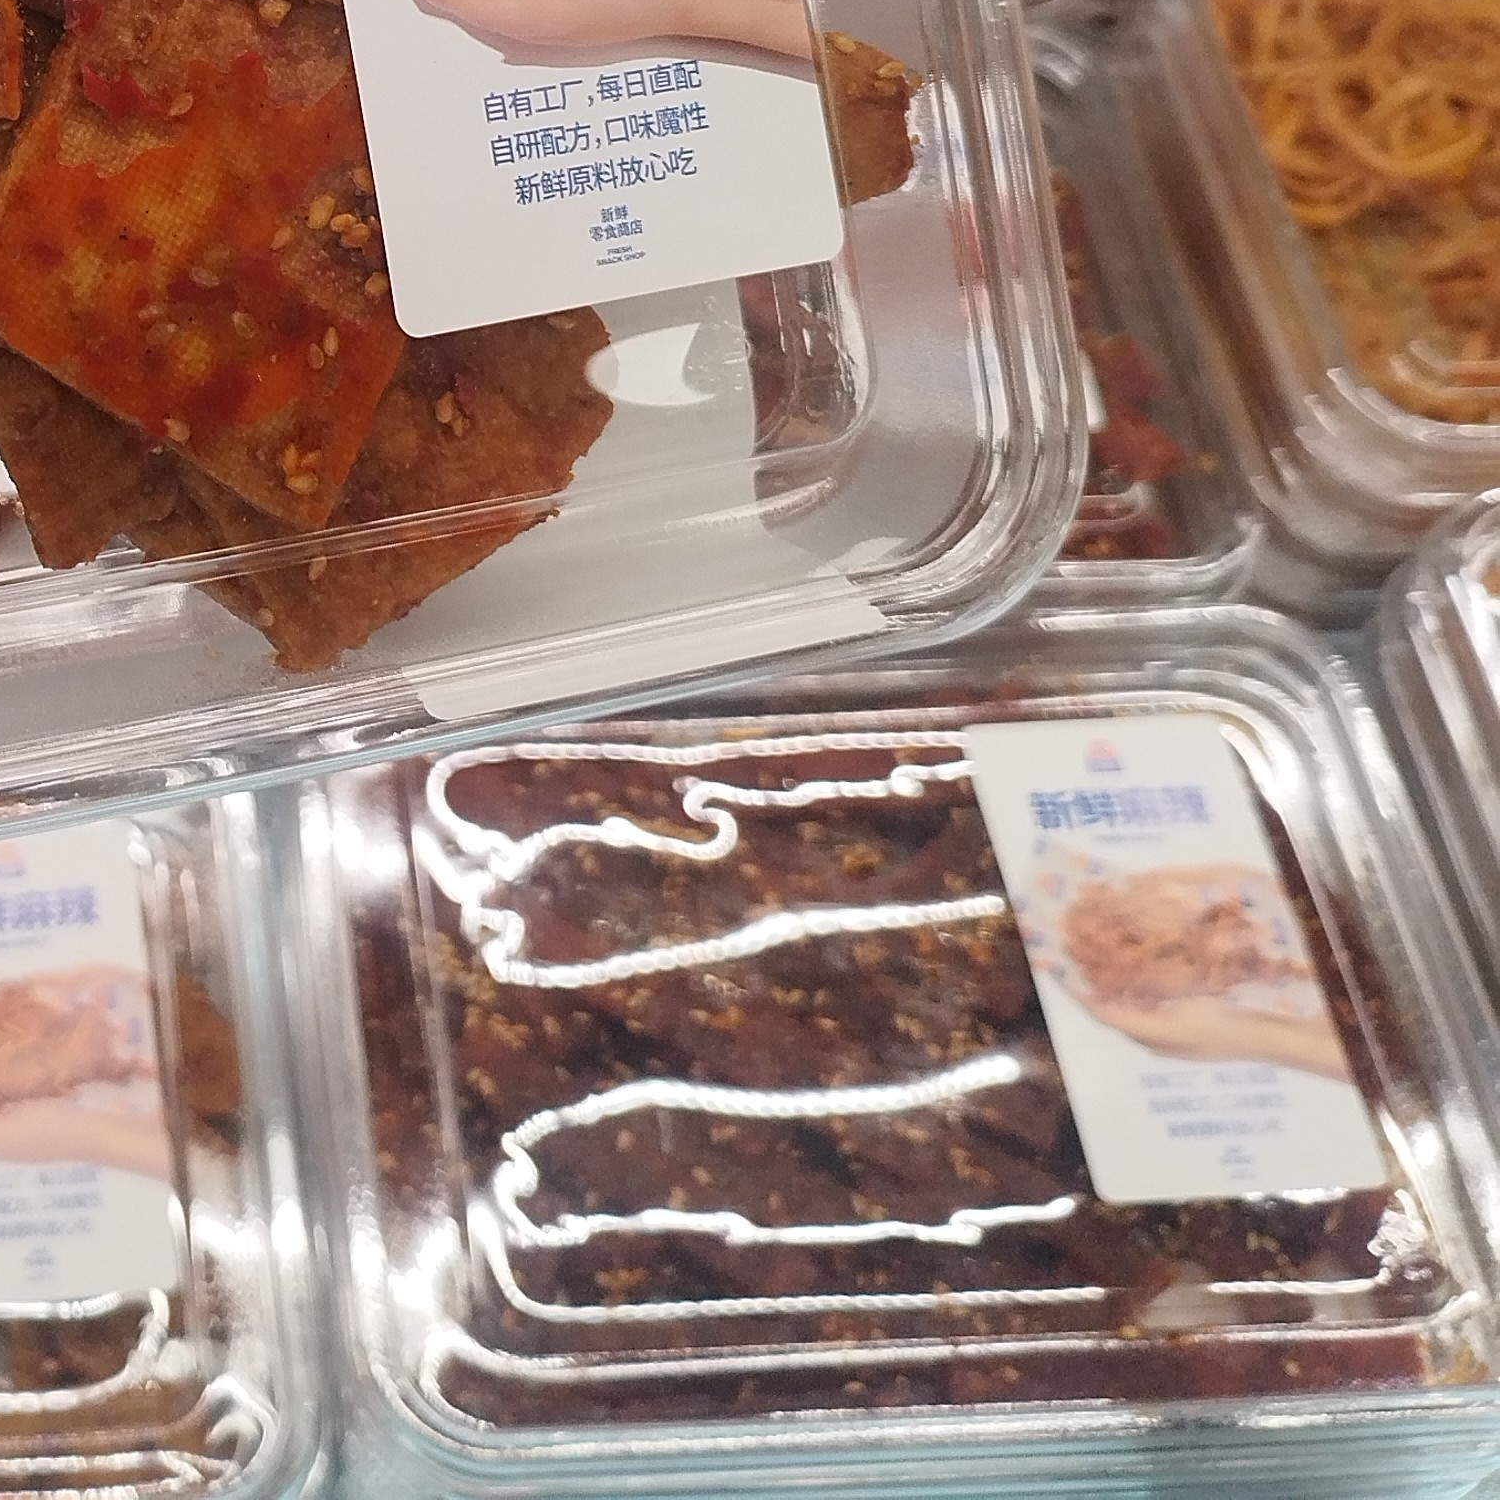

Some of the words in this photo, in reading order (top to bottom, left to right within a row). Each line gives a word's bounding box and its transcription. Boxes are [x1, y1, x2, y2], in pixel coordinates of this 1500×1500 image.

[483, 60, 703, 124] 自有工厂，每日直配
[490, 102, 710, 167] 自研配方，口味魔性
[514, 147, 698, 206] 新鲜原料放心吃
[600, 204, 628, 223] 新鲜
